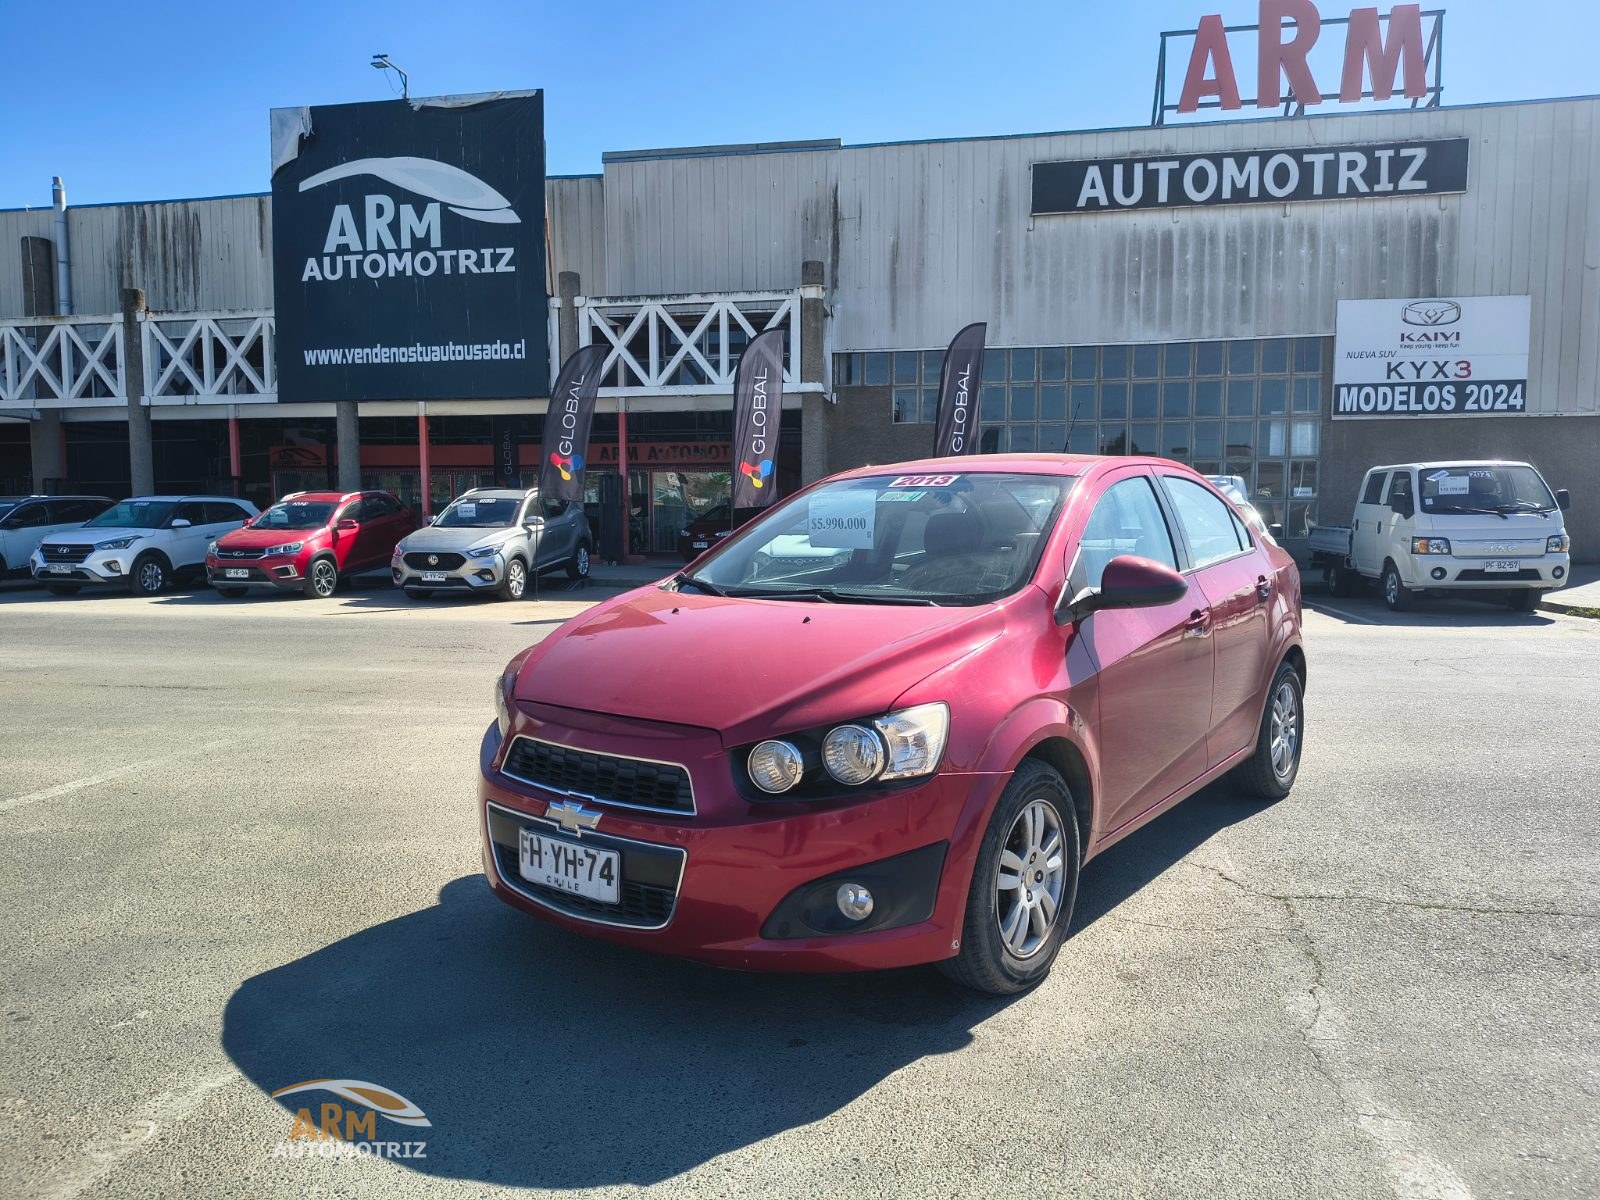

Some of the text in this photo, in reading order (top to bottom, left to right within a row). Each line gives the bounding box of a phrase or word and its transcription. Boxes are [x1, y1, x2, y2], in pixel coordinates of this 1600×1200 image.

[1177, 0, 1427, 114] ARM
[1076, 147, 1428, 208] AUTOMOTRIZ
[323, 194, 442, 254] ARM
[301, 247, 516, 282] AUTOMOTRIZ
[304, 338, 526, 366] www.vendenostuautousado.cl
[1346, 350, 1398, 359] NUEVA SUV
[1386, 360, 1472, 380] KYX3
[752, 367, 768, 455] GLOBAL
[952, 363, 970, 452] GLOBAL
[1339, 384, 1524, 412] MODELOS 2024
[558, 375, 585, 456] GLOBAL
[893, 475, 954, 487] 2013
[811, 517, 866, 530] $5.990.000
[546, 875, 580, 892] CHILE
